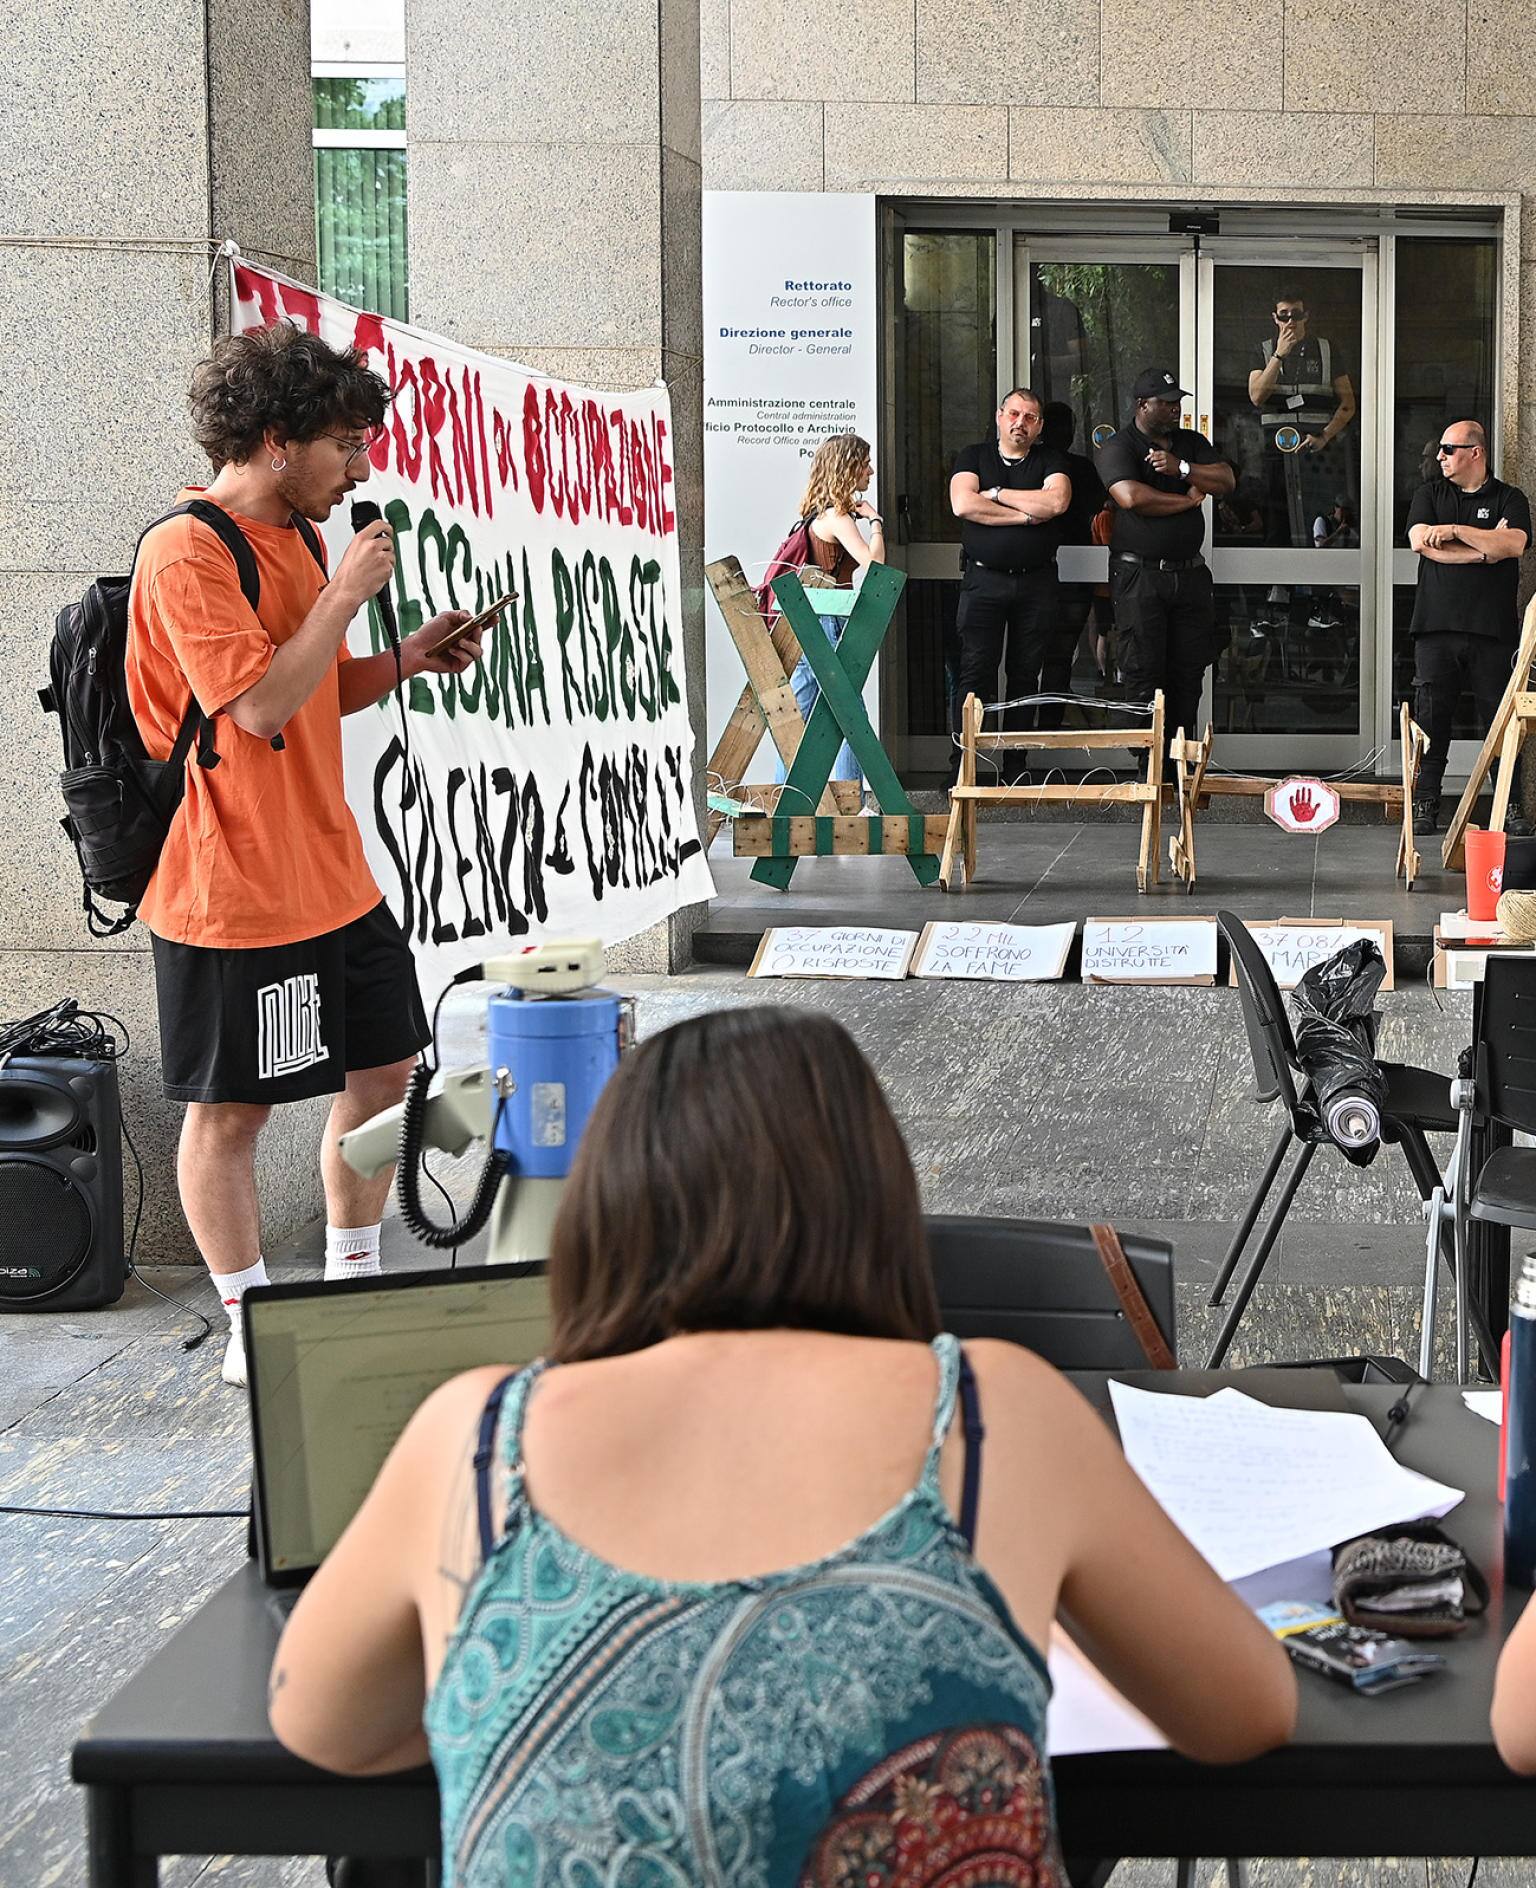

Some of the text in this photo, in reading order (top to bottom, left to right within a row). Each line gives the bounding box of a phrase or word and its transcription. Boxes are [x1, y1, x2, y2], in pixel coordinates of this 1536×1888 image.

[785, 280, 852, 291] Rettorato
[770, 296, 852, 307] Rector's office
[719, 327, 853, 340] Direzione generale
[749, 343, 795, 355] Director
[806, 343, 852, 355] General
[707, 397, 856, 409] Amministrazione centrale
[757, 411, 856, 421] Central administration
[704, 422, 856, 434] ficio Protocollo e Archivio
[737, 435, 771, 445] Record
[773, 436, 800, 445] Office
[803, 436, 821, 445] and
[523, 382, 675, 538] OCCUPAZIONE
[786, 929, 906, 946] 37 GIORNI DI
[1095, 925, 1145, 943] 12
[774, 942, 905, 959] OCCUPAZIONE
[935, 944, 1032, 961] SOFFRONO
[802, 957, 898, 973] RISPOSTE
[929, 960, 1023, 976] LA FAME
[1085, 957, 1172, 969] DISTRUTTE
